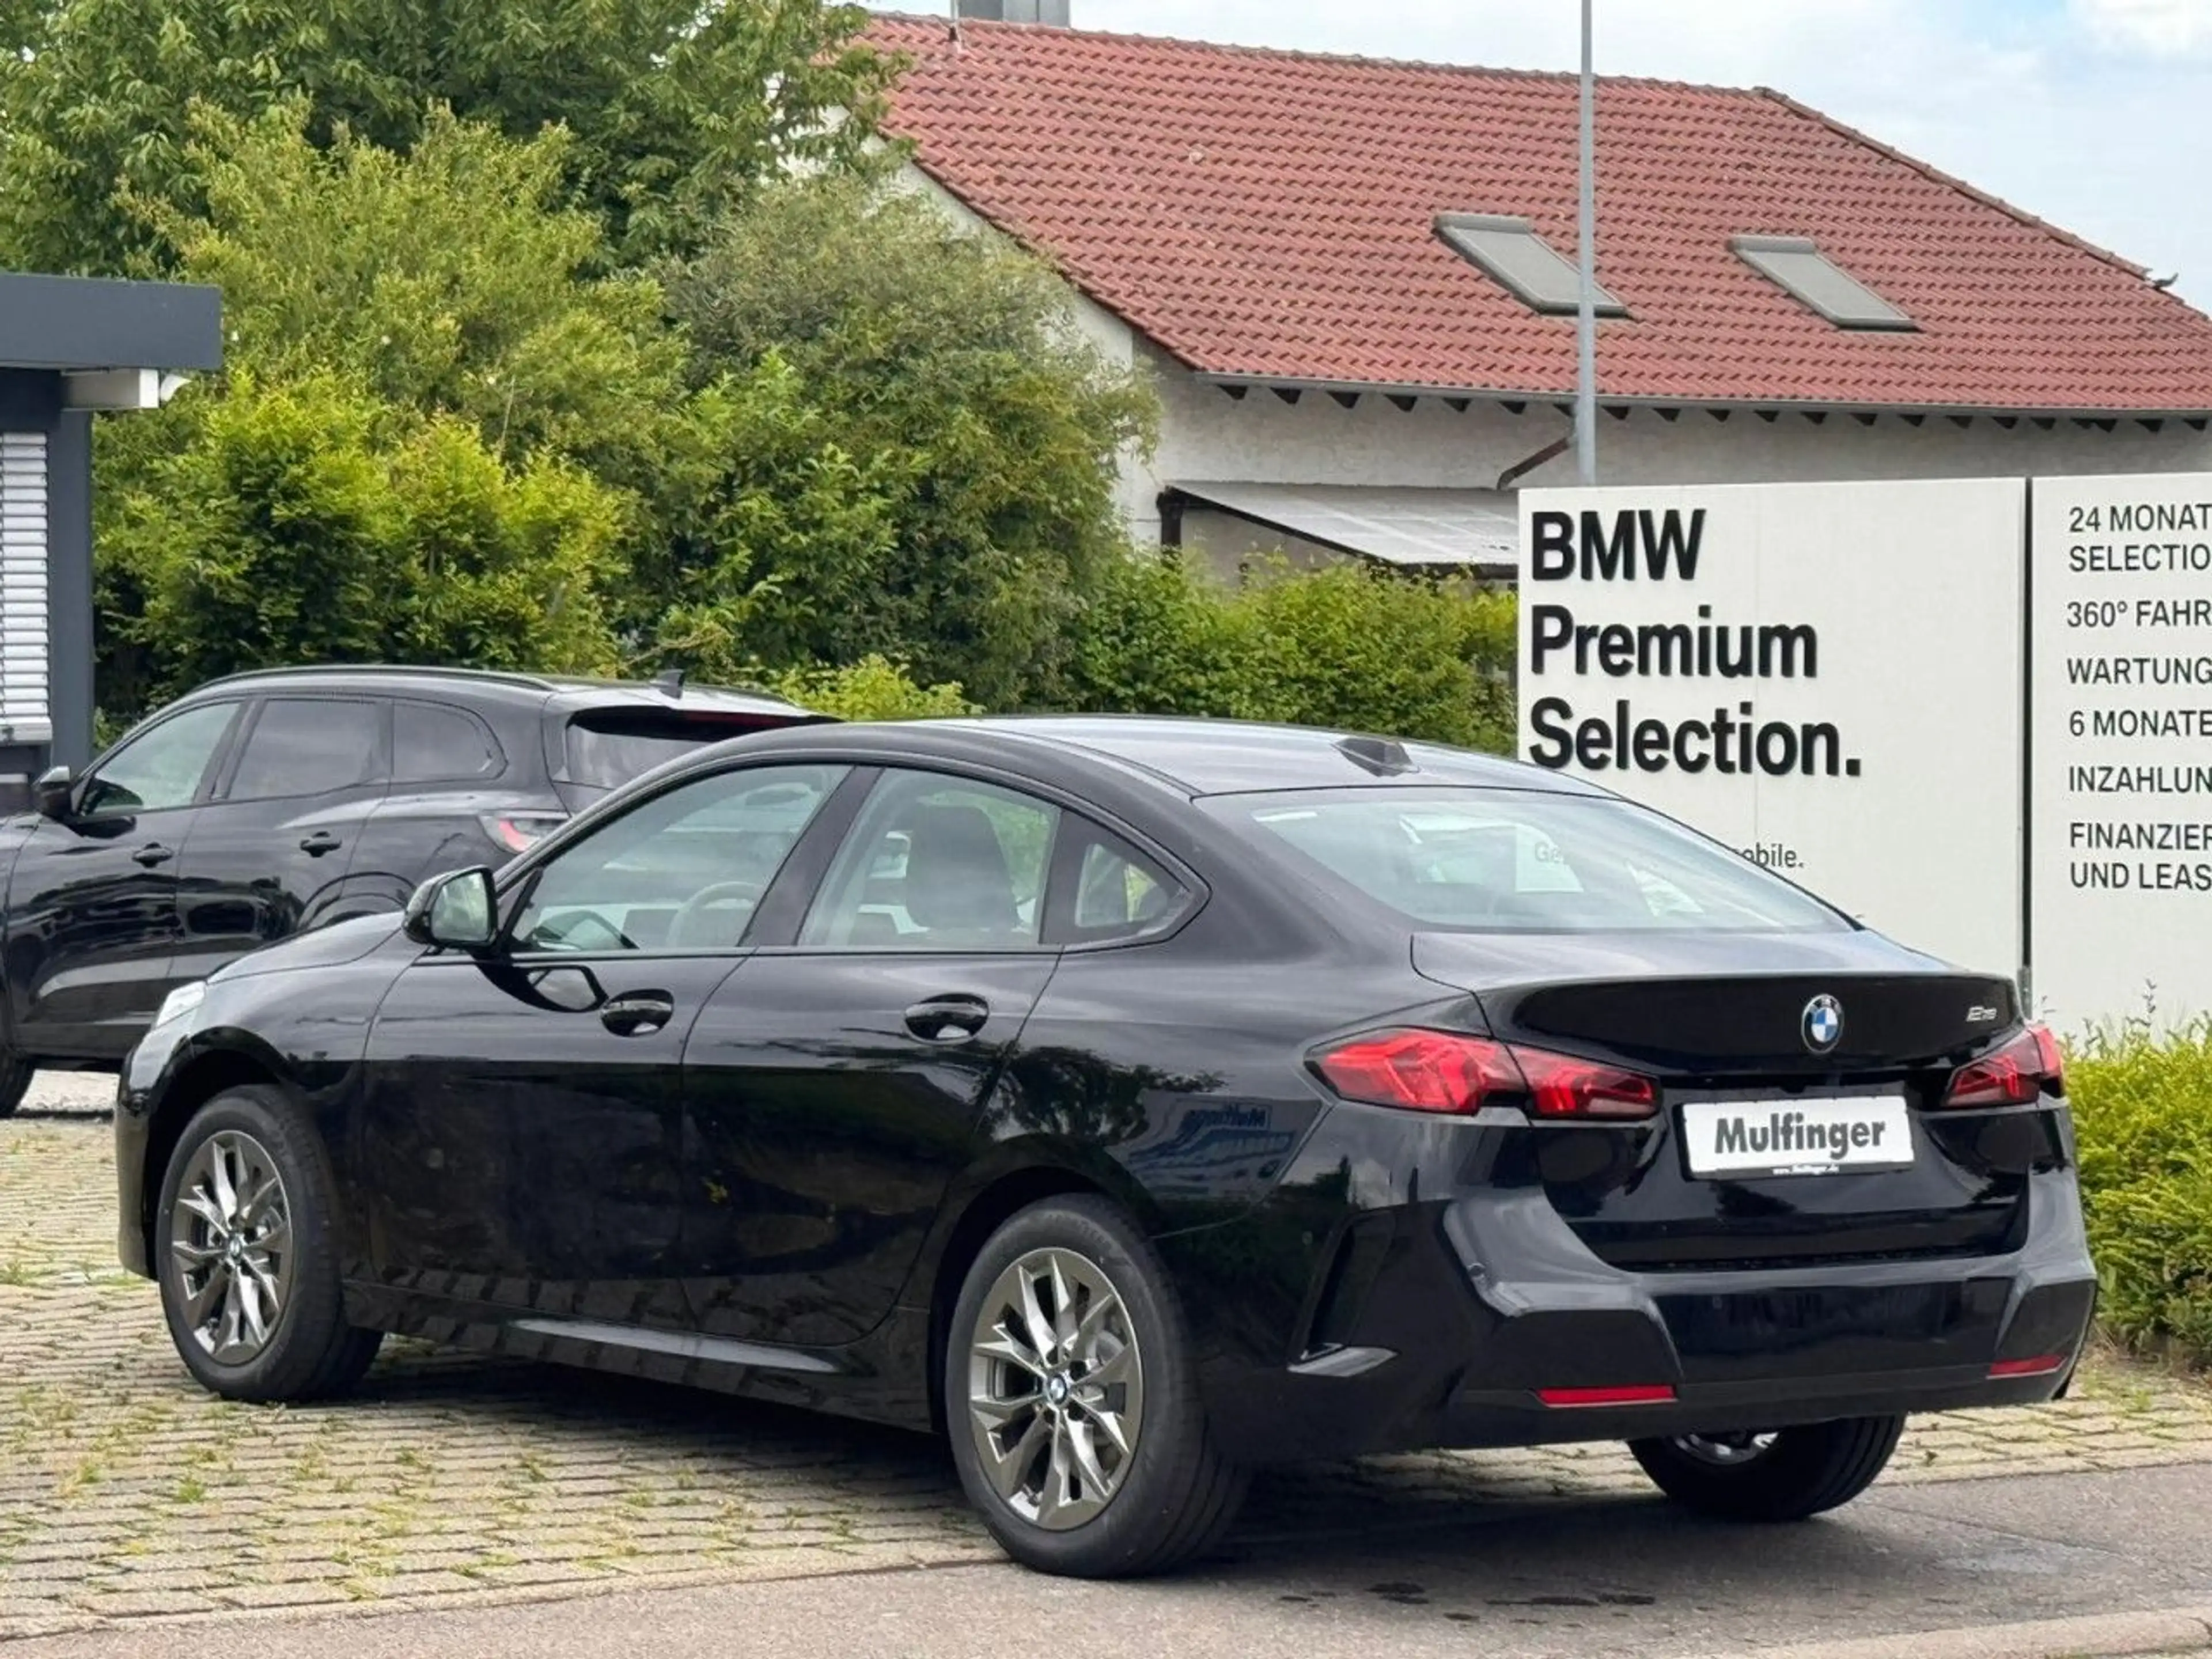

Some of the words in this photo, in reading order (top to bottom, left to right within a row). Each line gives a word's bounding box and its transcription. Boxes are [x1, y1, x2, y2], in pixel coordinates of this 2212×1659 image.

[2069, 506, 2100, 532] 24
[2109, 504, 2212, 532] MONAT
[1531, 509, 1706, 581] BMW
[2069, 543, 2211, 572] SELECTIO
[2136, 600, 2212, 627] FAHR
[1531, 605, 1817, 678] Premium
[2067, 657, 2212, 684] WARTUNG
[1529, 697, 1861, 777] Selection.
[2069, 710, 2085, 736] 6
[2093, 710, 2212, 736] MONATE
[2069, 766, 2212, 793] INZAHLUN
[2070, 862, 2130, 888] UND
[2139, 862, 2212, 891] LEAS
[1714, 1112, 1886, 1160] Mulfinger
